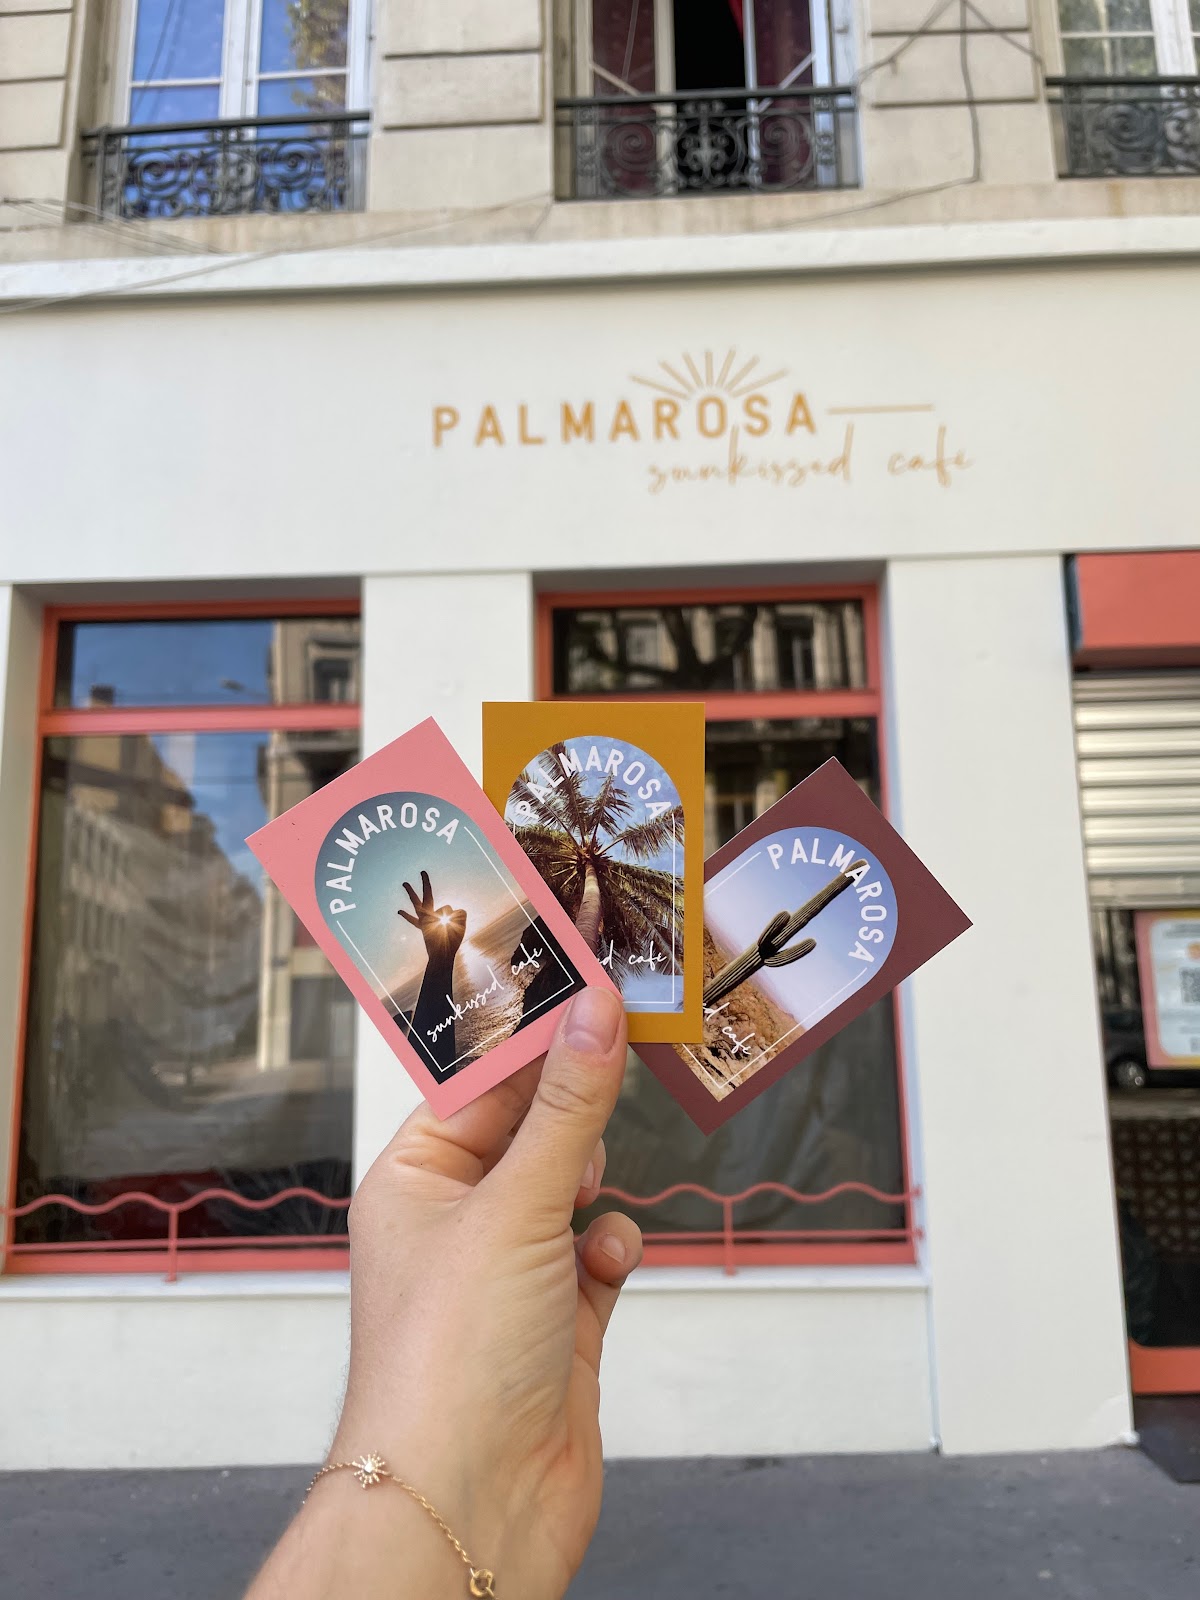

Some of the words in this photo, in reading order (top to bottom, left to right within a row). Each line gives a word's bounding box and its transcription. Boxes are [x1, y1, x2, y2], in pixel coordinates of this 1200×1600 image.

[432, 393, 817, 447] PALMAROSA
[517, 746, 672, 822] PALMAROSA
[325, 802, 460, 915] PALMAROSA
[767, 838, 887, 963] PALMAROSA
[426, 963, 505, 1043] sunkissed
[511, 942, 543, 976] cafe
[628, 940, 668, 972] cafe
